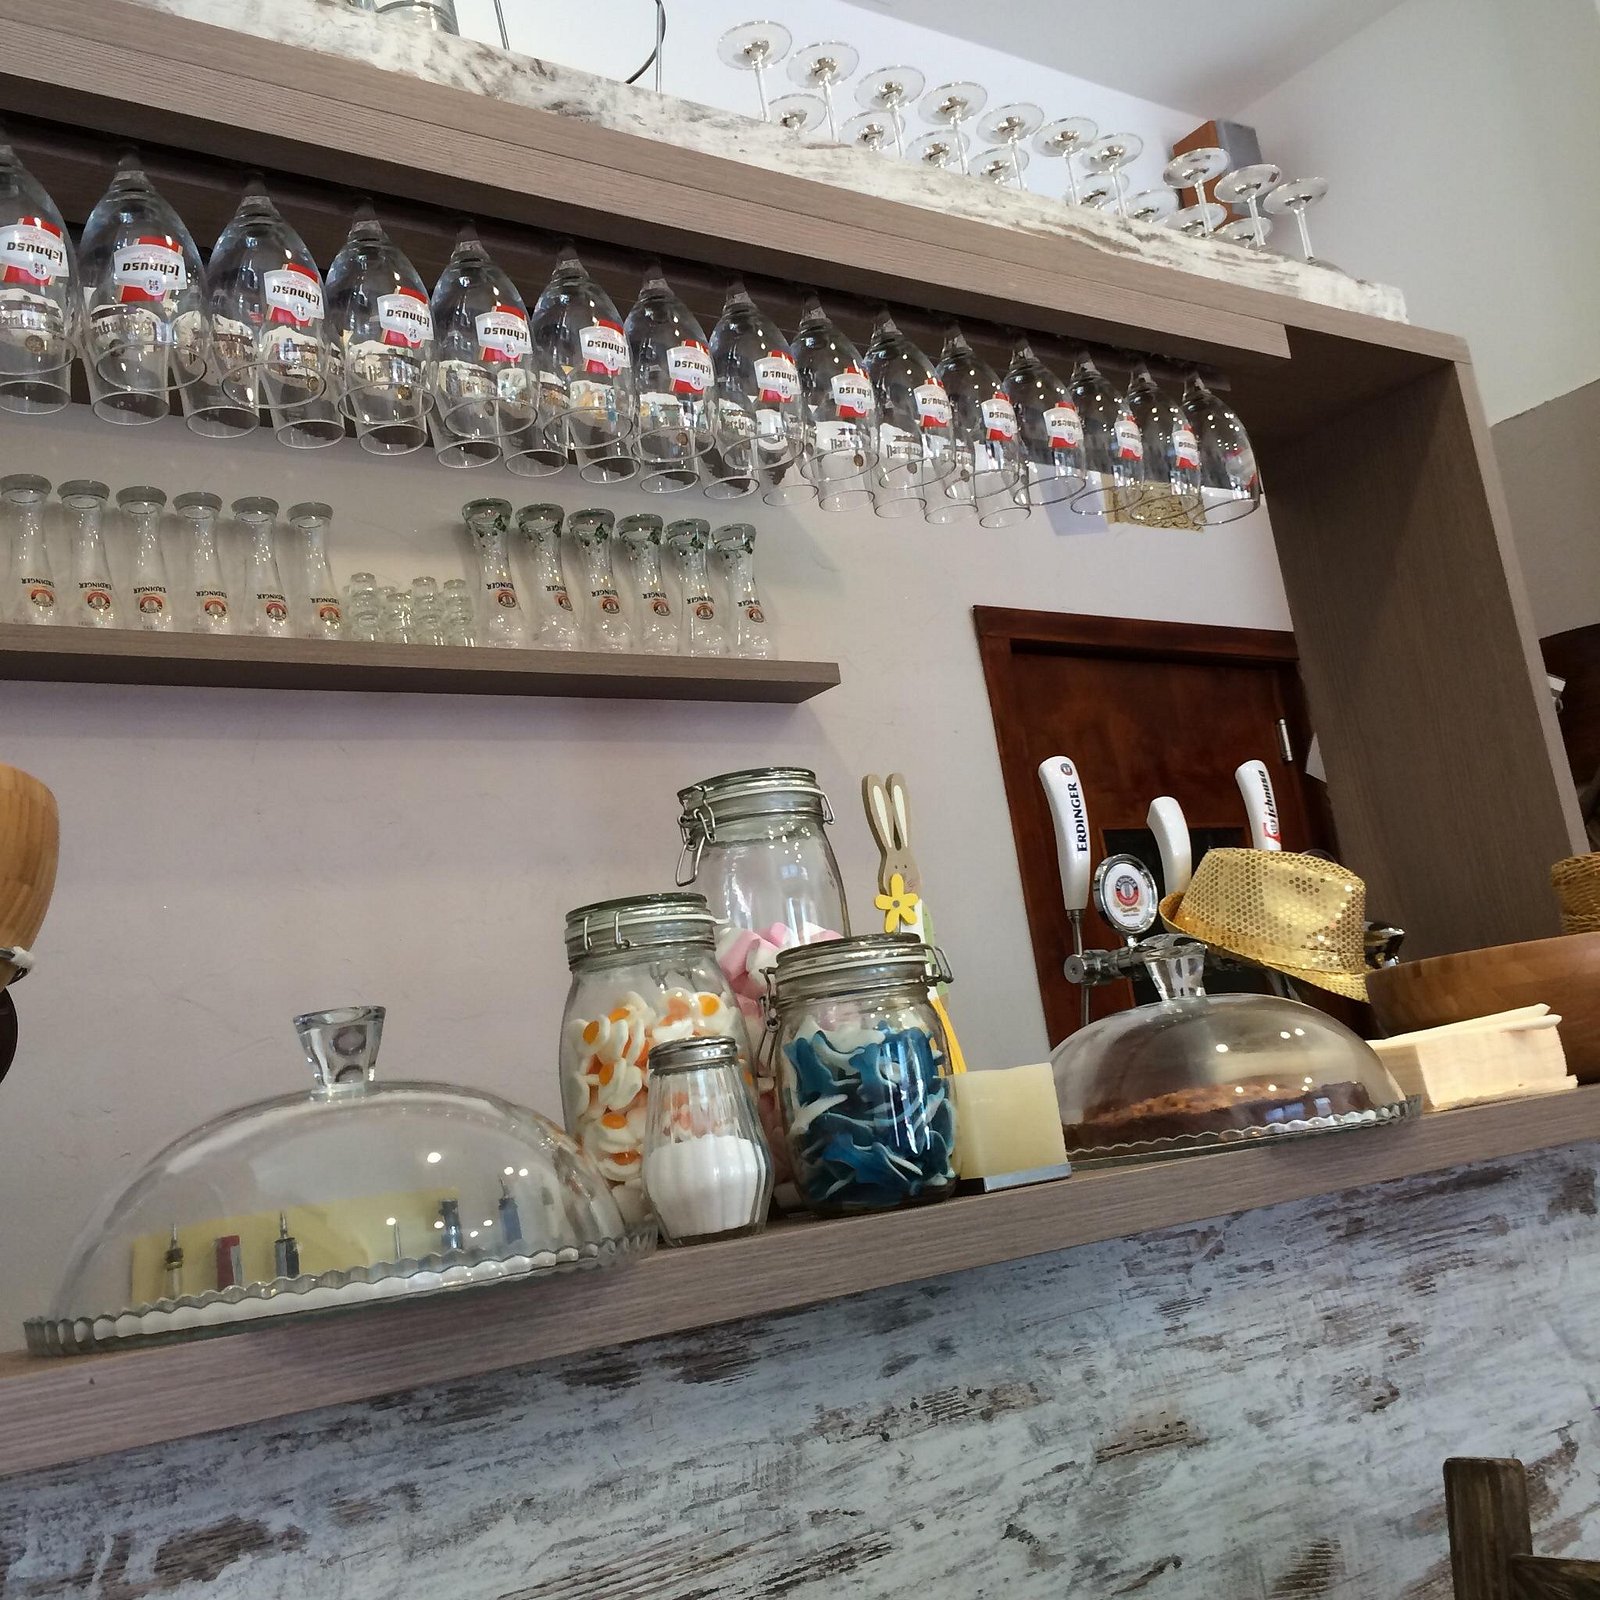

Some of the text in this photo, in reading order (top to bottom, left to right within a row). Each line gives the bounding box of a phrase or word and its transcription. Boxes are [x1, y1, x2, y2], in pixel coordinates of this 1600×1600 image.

[7, 241, 63, 266] ichnusa
[122, 261, 180, 280] ichnusa
[272, 285, 320, 309] ichnusa
[386, 308, 430, 331] ichnusa
[484, 327, 528, 346] ichnusa
[79, 582, 112, 591] ERDINGER
[133, 586, 167, 594] ERDINGER
[1258, 770, 1277, 818] ichnusa
[1067, 782, 1088, 852] ERDINGER
